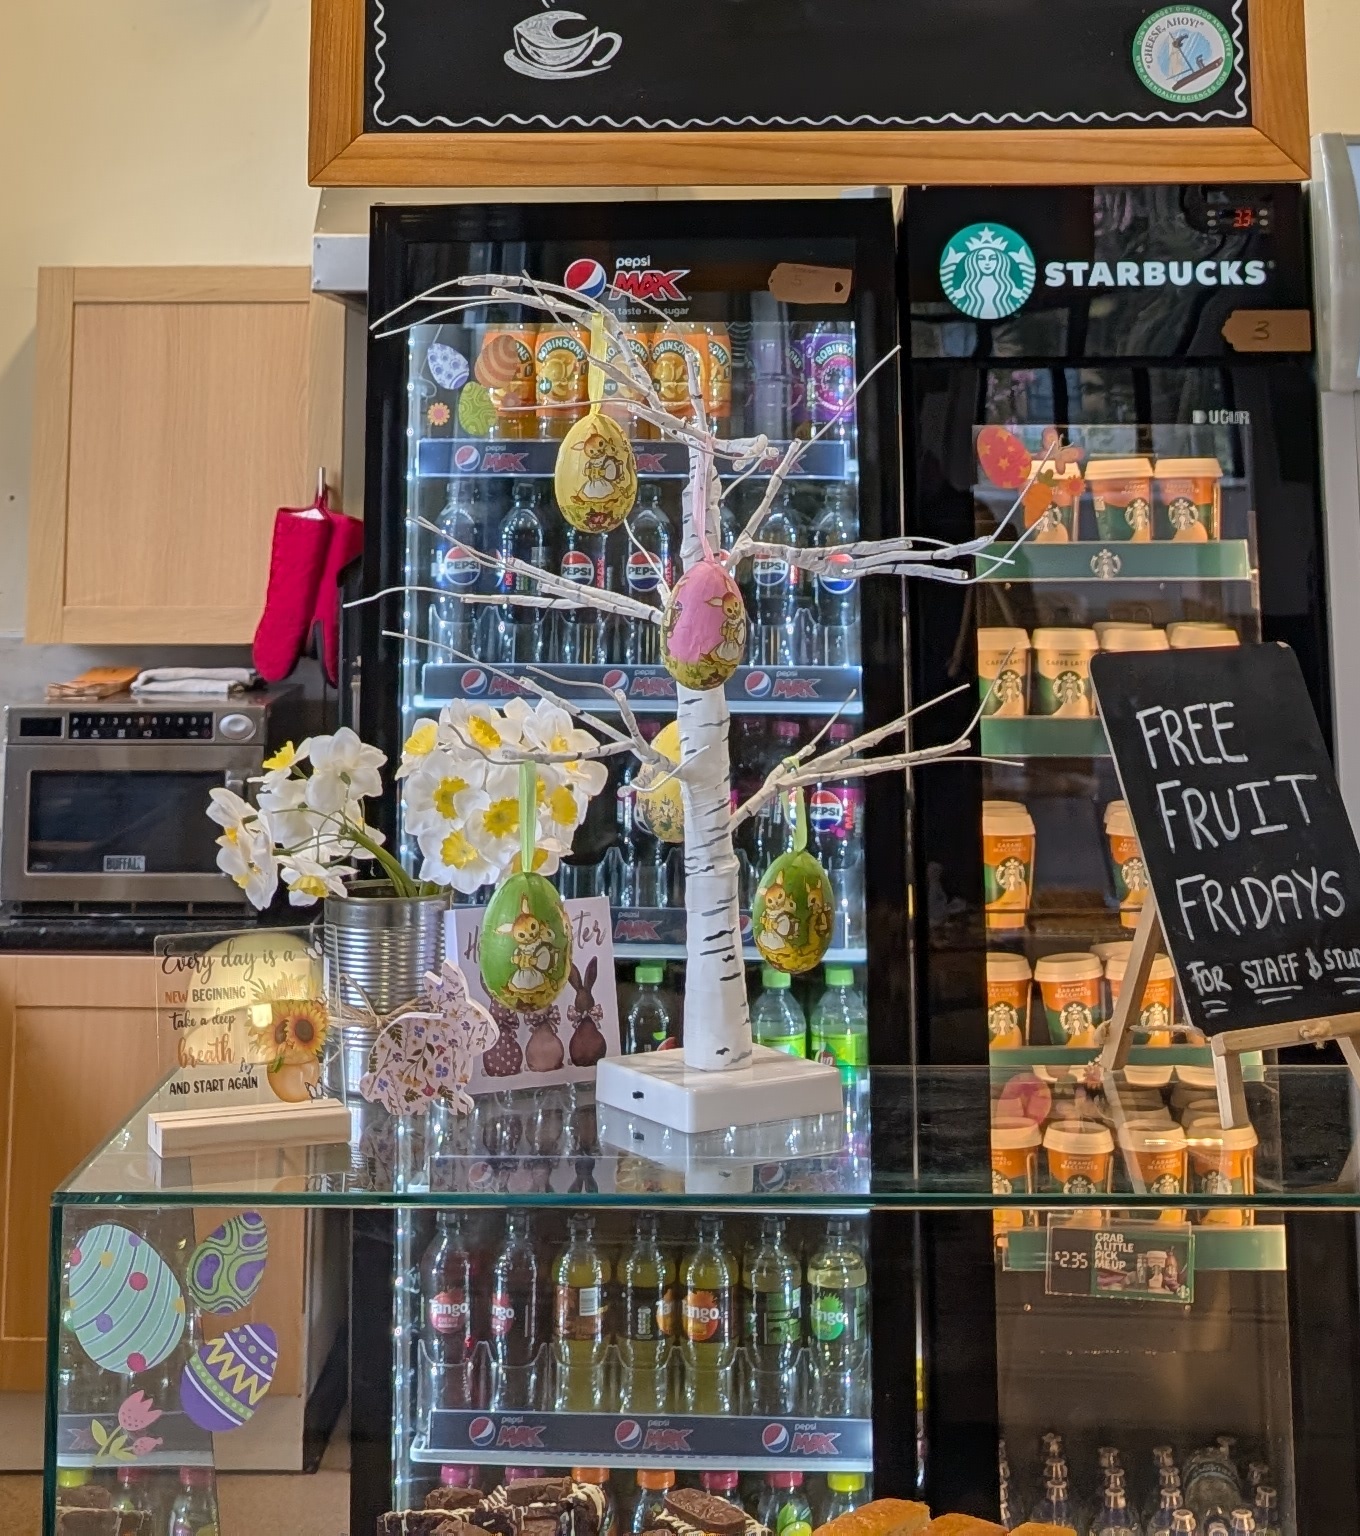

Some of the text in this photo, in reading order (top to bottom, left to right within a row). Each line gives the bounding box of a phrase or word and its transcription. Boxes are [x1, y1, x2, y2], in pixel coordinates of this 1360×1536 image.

[616, 255, 651, 268] pepsi
[1045, 260, 1266, 287] STARBUCKS
[609, 269, 690, 301] MAX
[538, 338, 587, 360] ROBINSONS
[1136, 702, 1248, 769] FREE
[1156, 774, 1317, 853] FRUIT
[1176, 867, 1345, 941] FRIDAYS
[161, 938, 296, 983] Every day is a
[1187, 952, 1299, 995] FOR STAFF
[164, 986, 245, 1003] NEW BEGINNING
[169, 1075, 258, 1095] AND START AGAIN
